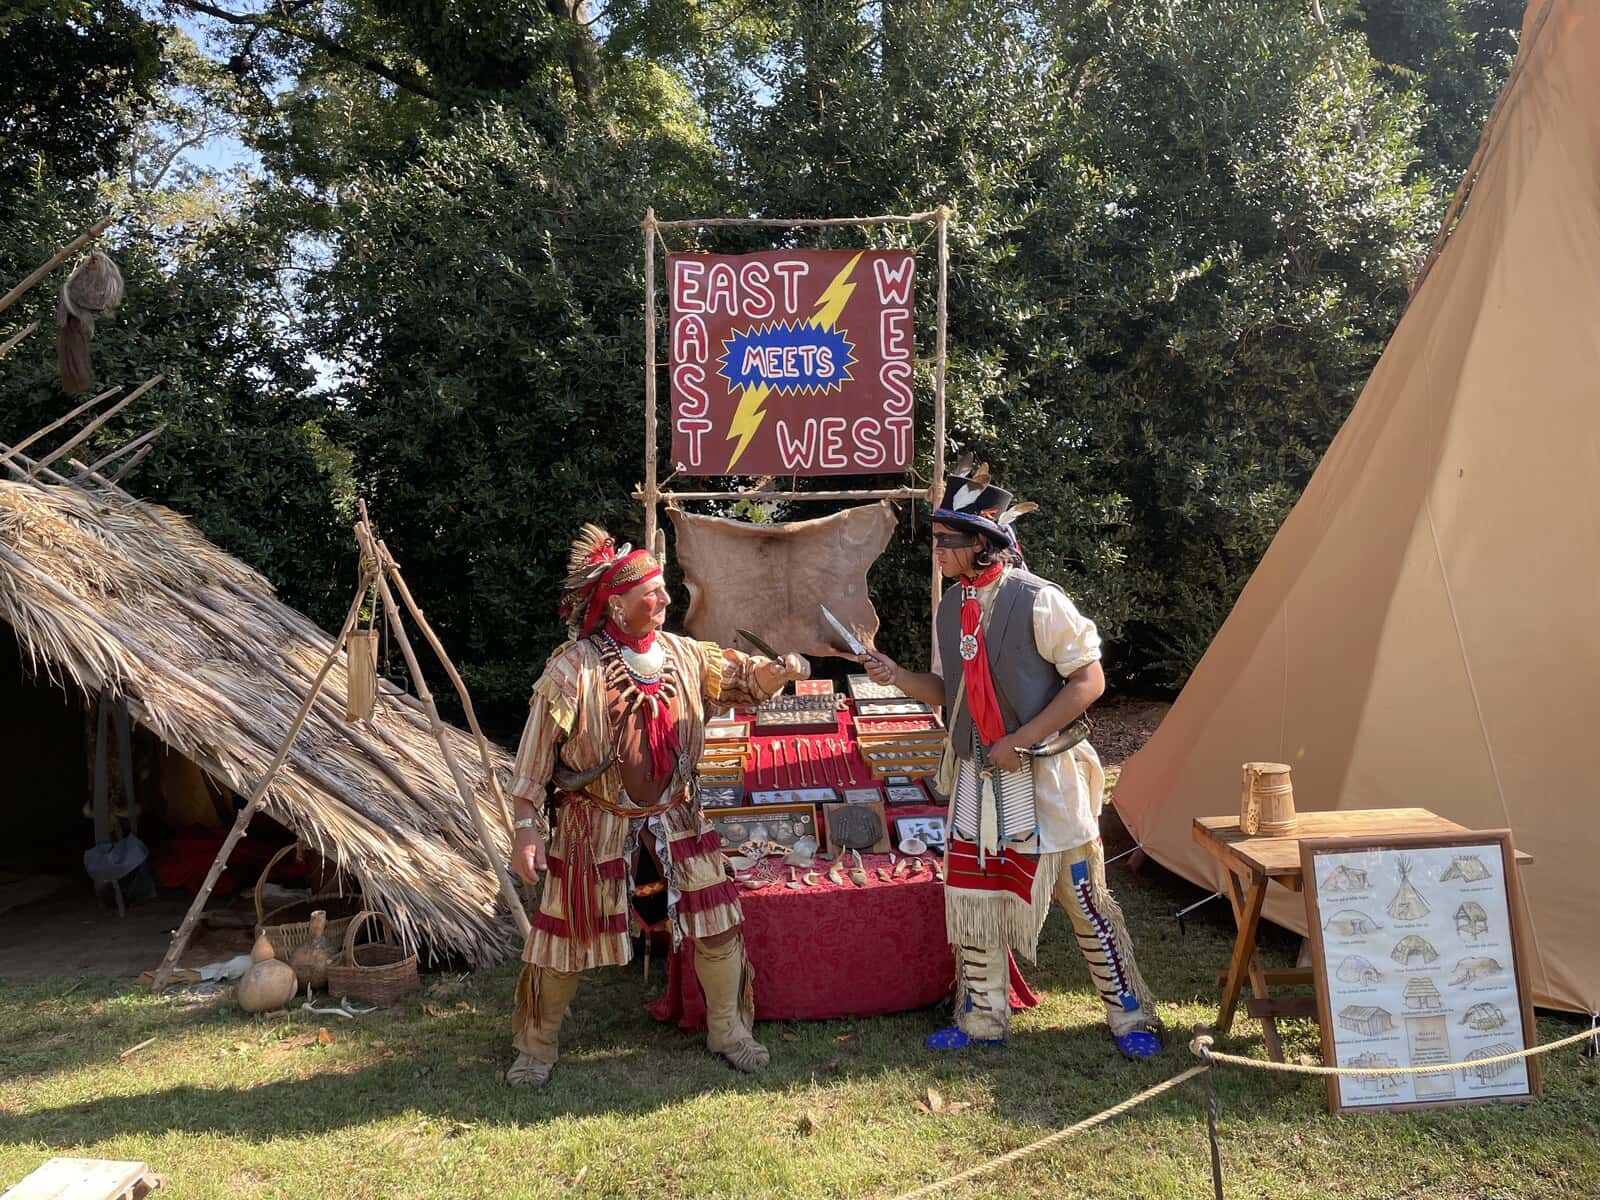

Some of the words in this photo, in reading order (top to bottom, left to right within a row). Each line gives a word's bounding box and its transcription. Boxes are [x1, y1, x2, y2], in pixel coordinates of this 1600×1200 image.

[674, 260, 809, 318] EAST
[673, 260, 713, 466] EAST
[741, 346, 835, 378] MEETS
[873, 257, 914, 466] WEST
[776, 417, 913, 469] WEST
